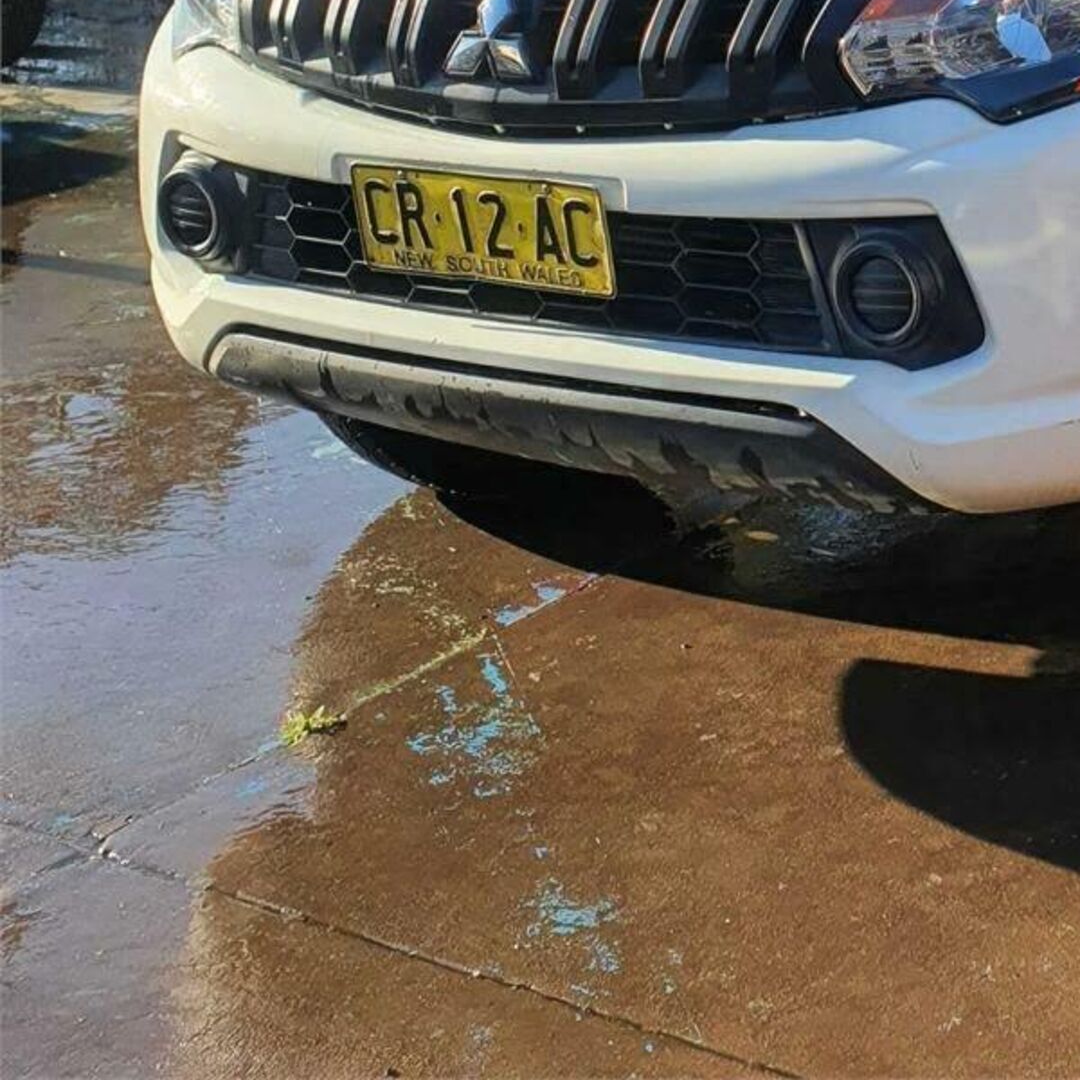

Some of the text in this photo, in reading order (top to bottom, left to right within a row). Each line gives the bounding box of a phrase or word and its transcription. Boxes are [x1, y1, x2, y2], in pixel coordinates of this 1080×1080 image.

[394, 250, 582, 287] NEW SOUTH WALES
